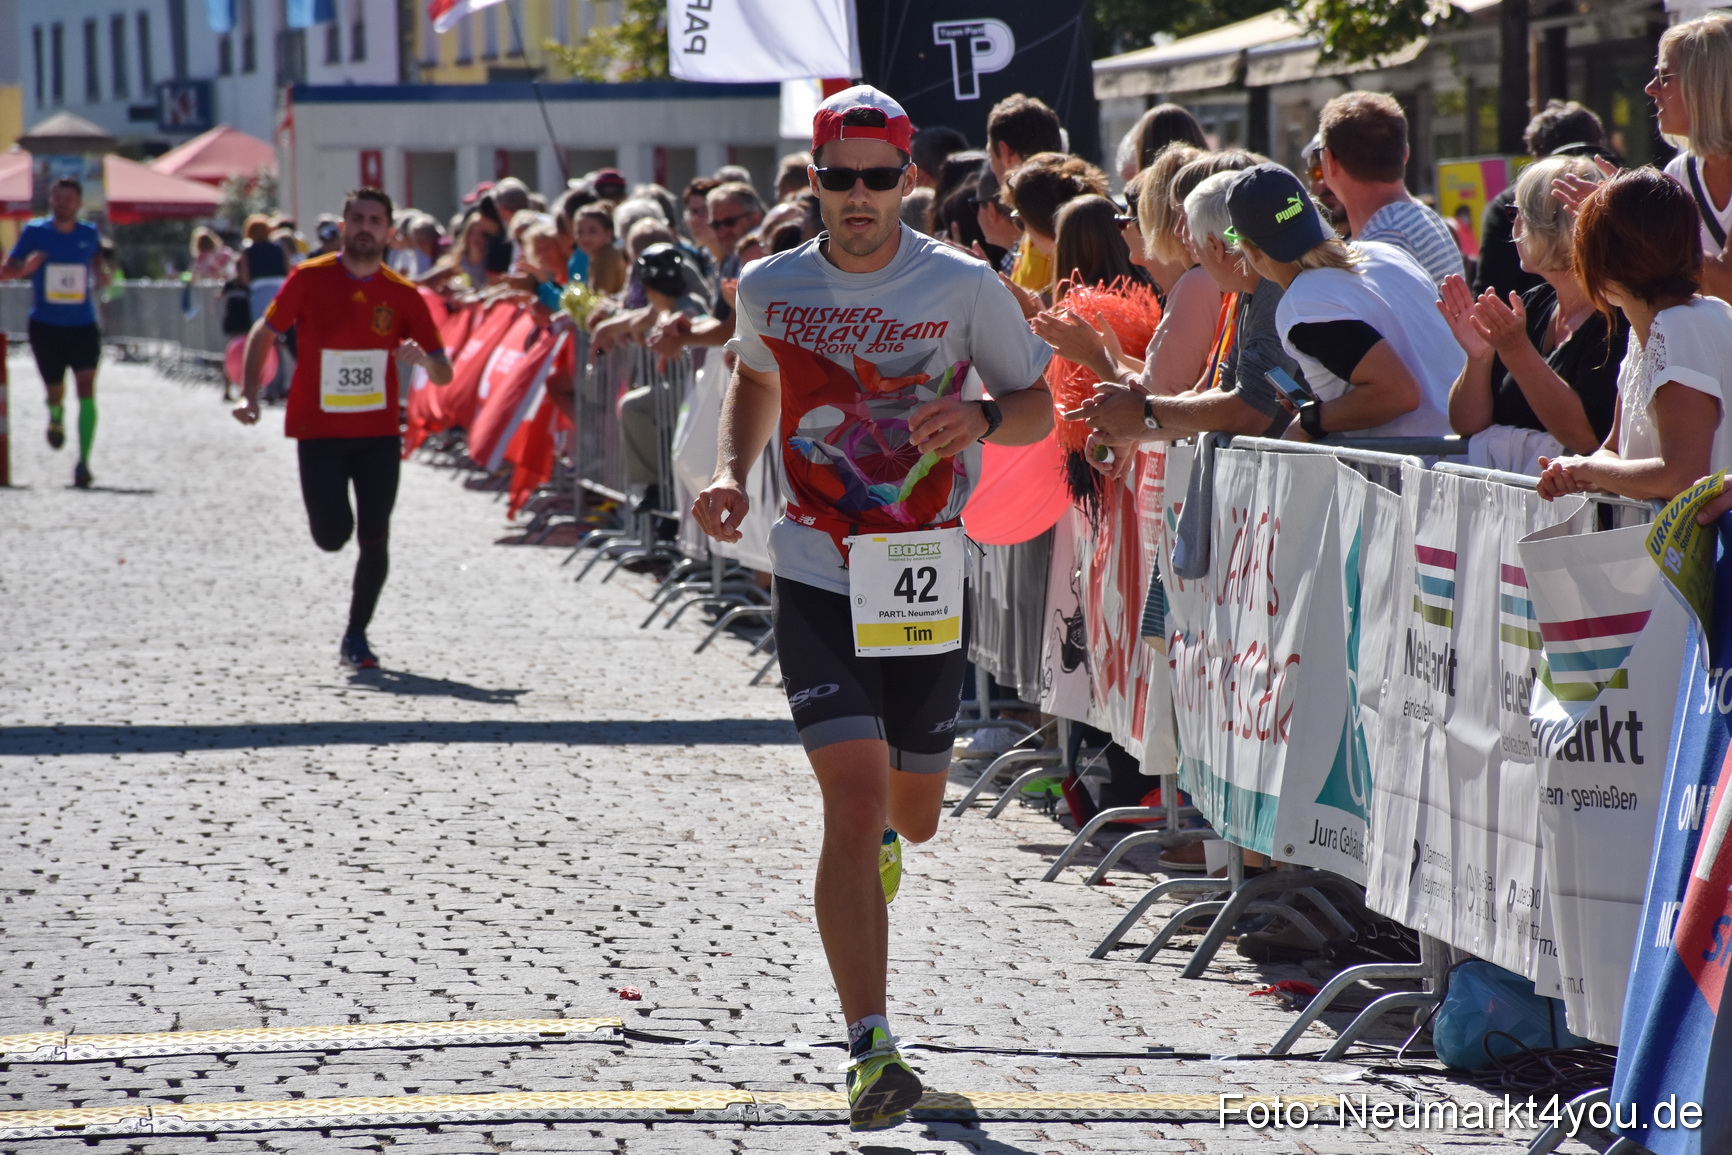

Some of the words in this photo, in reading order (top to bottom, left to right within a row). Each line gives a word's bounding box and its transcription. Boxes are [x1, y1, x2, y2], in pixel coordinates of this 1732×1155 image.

[1275, 202, 1303, 224] PUMA
[763, 301, 884, 327] FINISHER
[783, 319, 870, 346] RELAY
[873, 319, 949, 346] TEAM
[813, 341, 857, 355] ROTH
[864, 342, 905, 354] 2016
[338, 366, 374, 387] 338
[1650, 475, 1720, 556] URKUNDE
[888, 541, 942, 557] BOCK
[894, 566, 939, 604] 42
[879, 610, 906, 618] PARTL
[908, 608, 943, 617] Neumarkt
[903, 626, 933, 641] Tim
[1571, 784, 1638, 812] genießen
[1309, 818, 1338, 851] Jura
